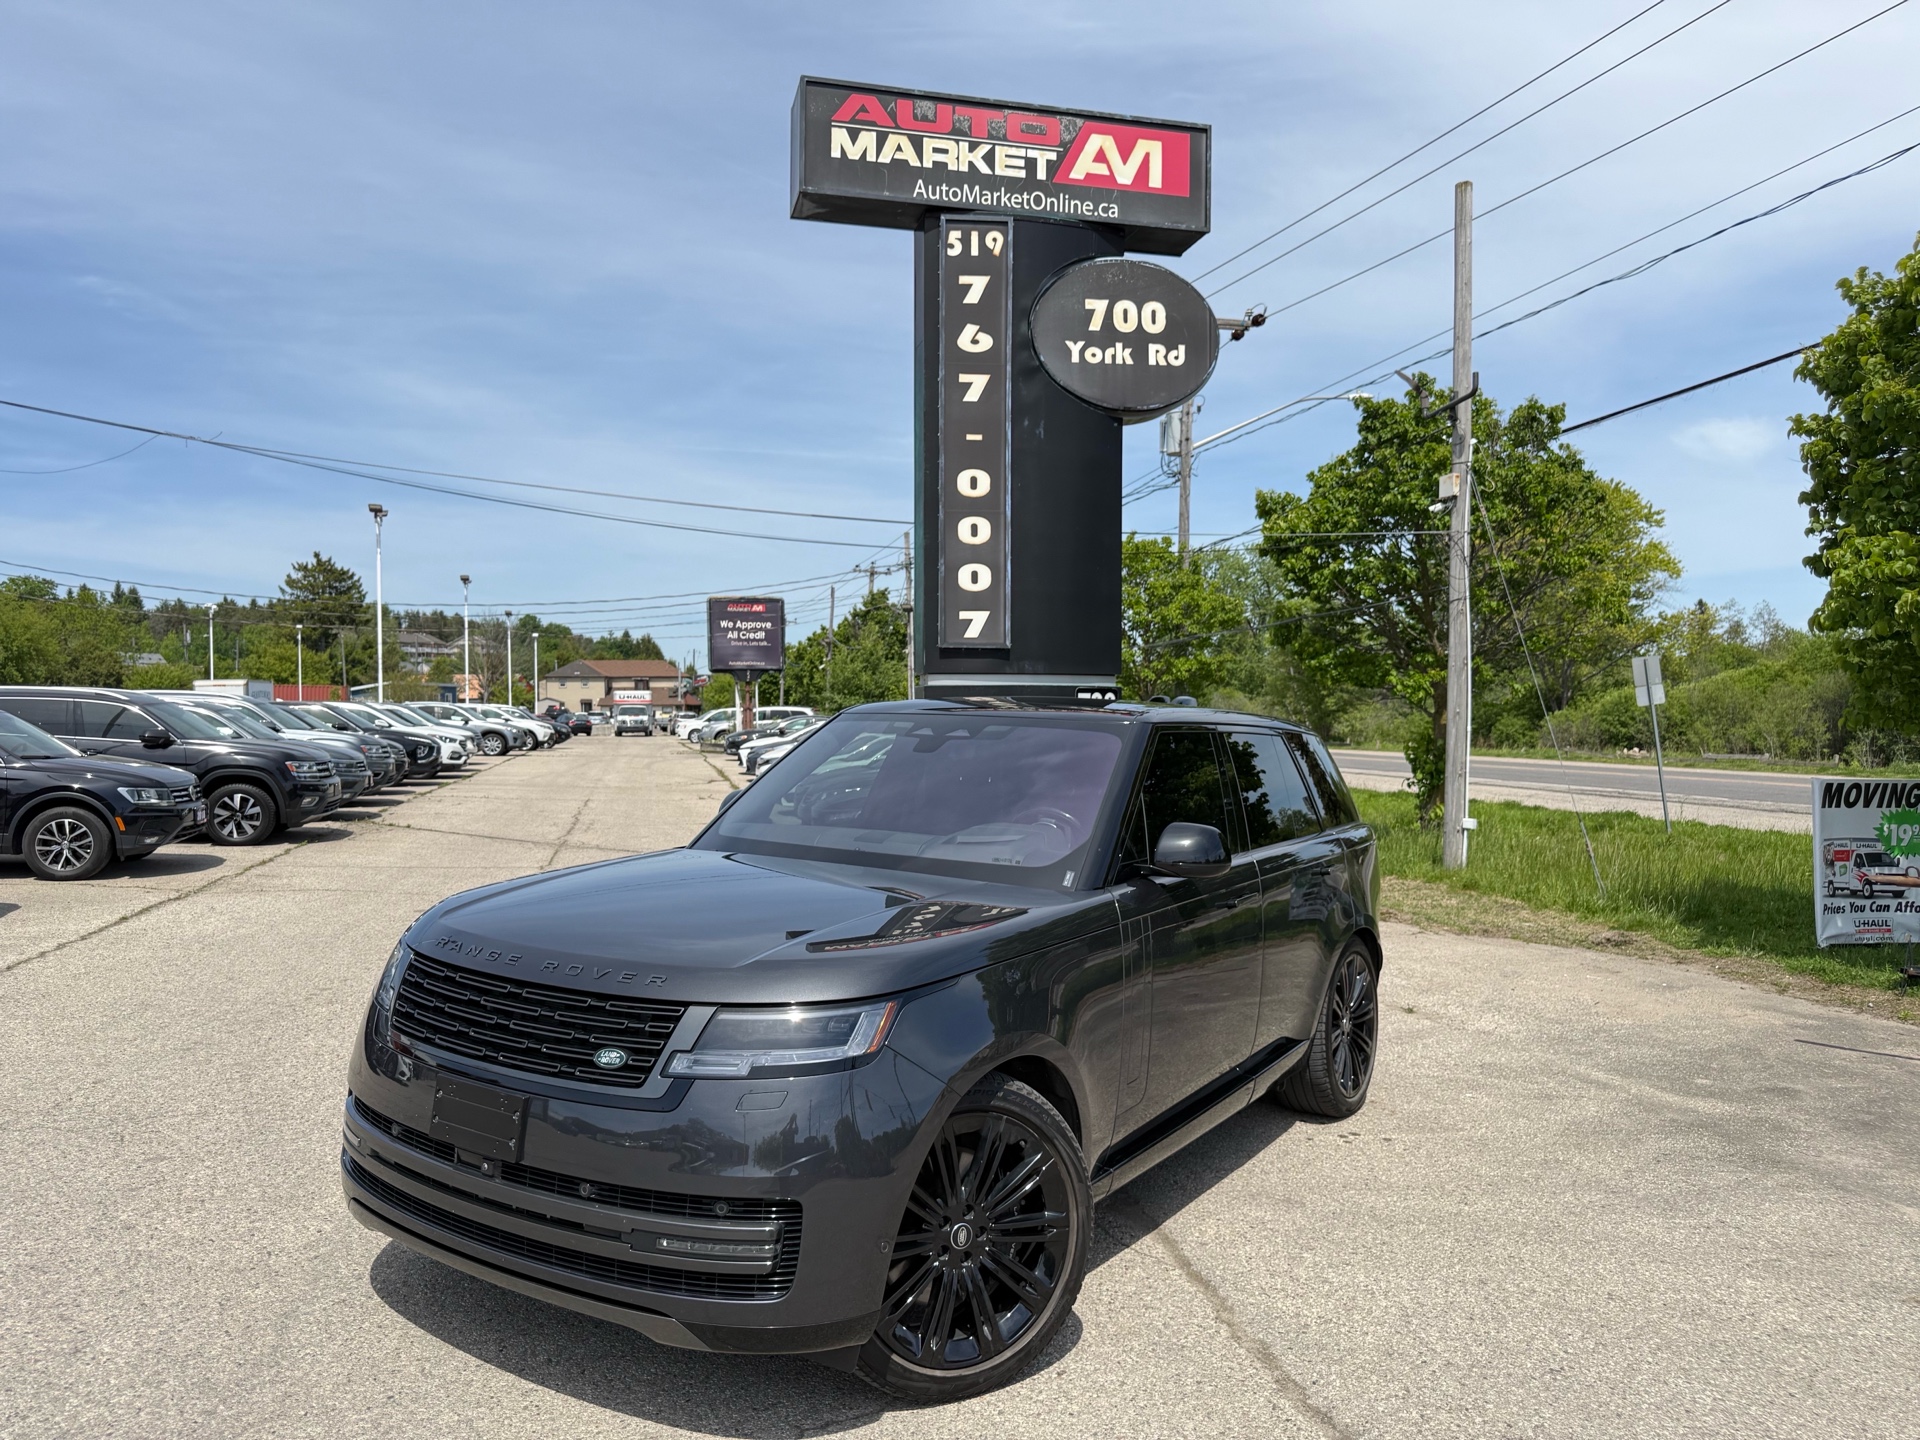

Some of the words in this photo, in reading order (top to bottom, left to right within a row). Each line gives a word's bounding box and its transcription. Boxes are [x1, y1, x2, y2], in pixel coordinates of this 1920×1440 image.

[831, 94, 1061, 146] AUTO
[831, 127, 1058, 181] MARKET
[1069, 133, 1163, 189] AM
[913, 179, 1119, 219] AutoMarketOnline.ca
[946, 230, 1005, 258] 519
[1084, 298, 1167, 335] 700
[1064, 339, 1134, 365] York
[1148, 343, 1186, 367] Rd
[720, 620, 734, 628] We
[736, 620, 772, 630] Approve
[727, 631, 738, 639] All
[740, 631, 765, 639] Credit
[1821, 782, 1920, 809] MOVING
[1823, 902, 1846, 916] Prices
[1849, 901, 1866, 913] You
[1869, 901, 1891, 913] Can
[1854, 920, 1892, 928] U-HAUL
[435, 936, 523, 966] RANGE
[540, 960, 668, 988] ROVER
[600, 1056, 620, 1064] ROVER
